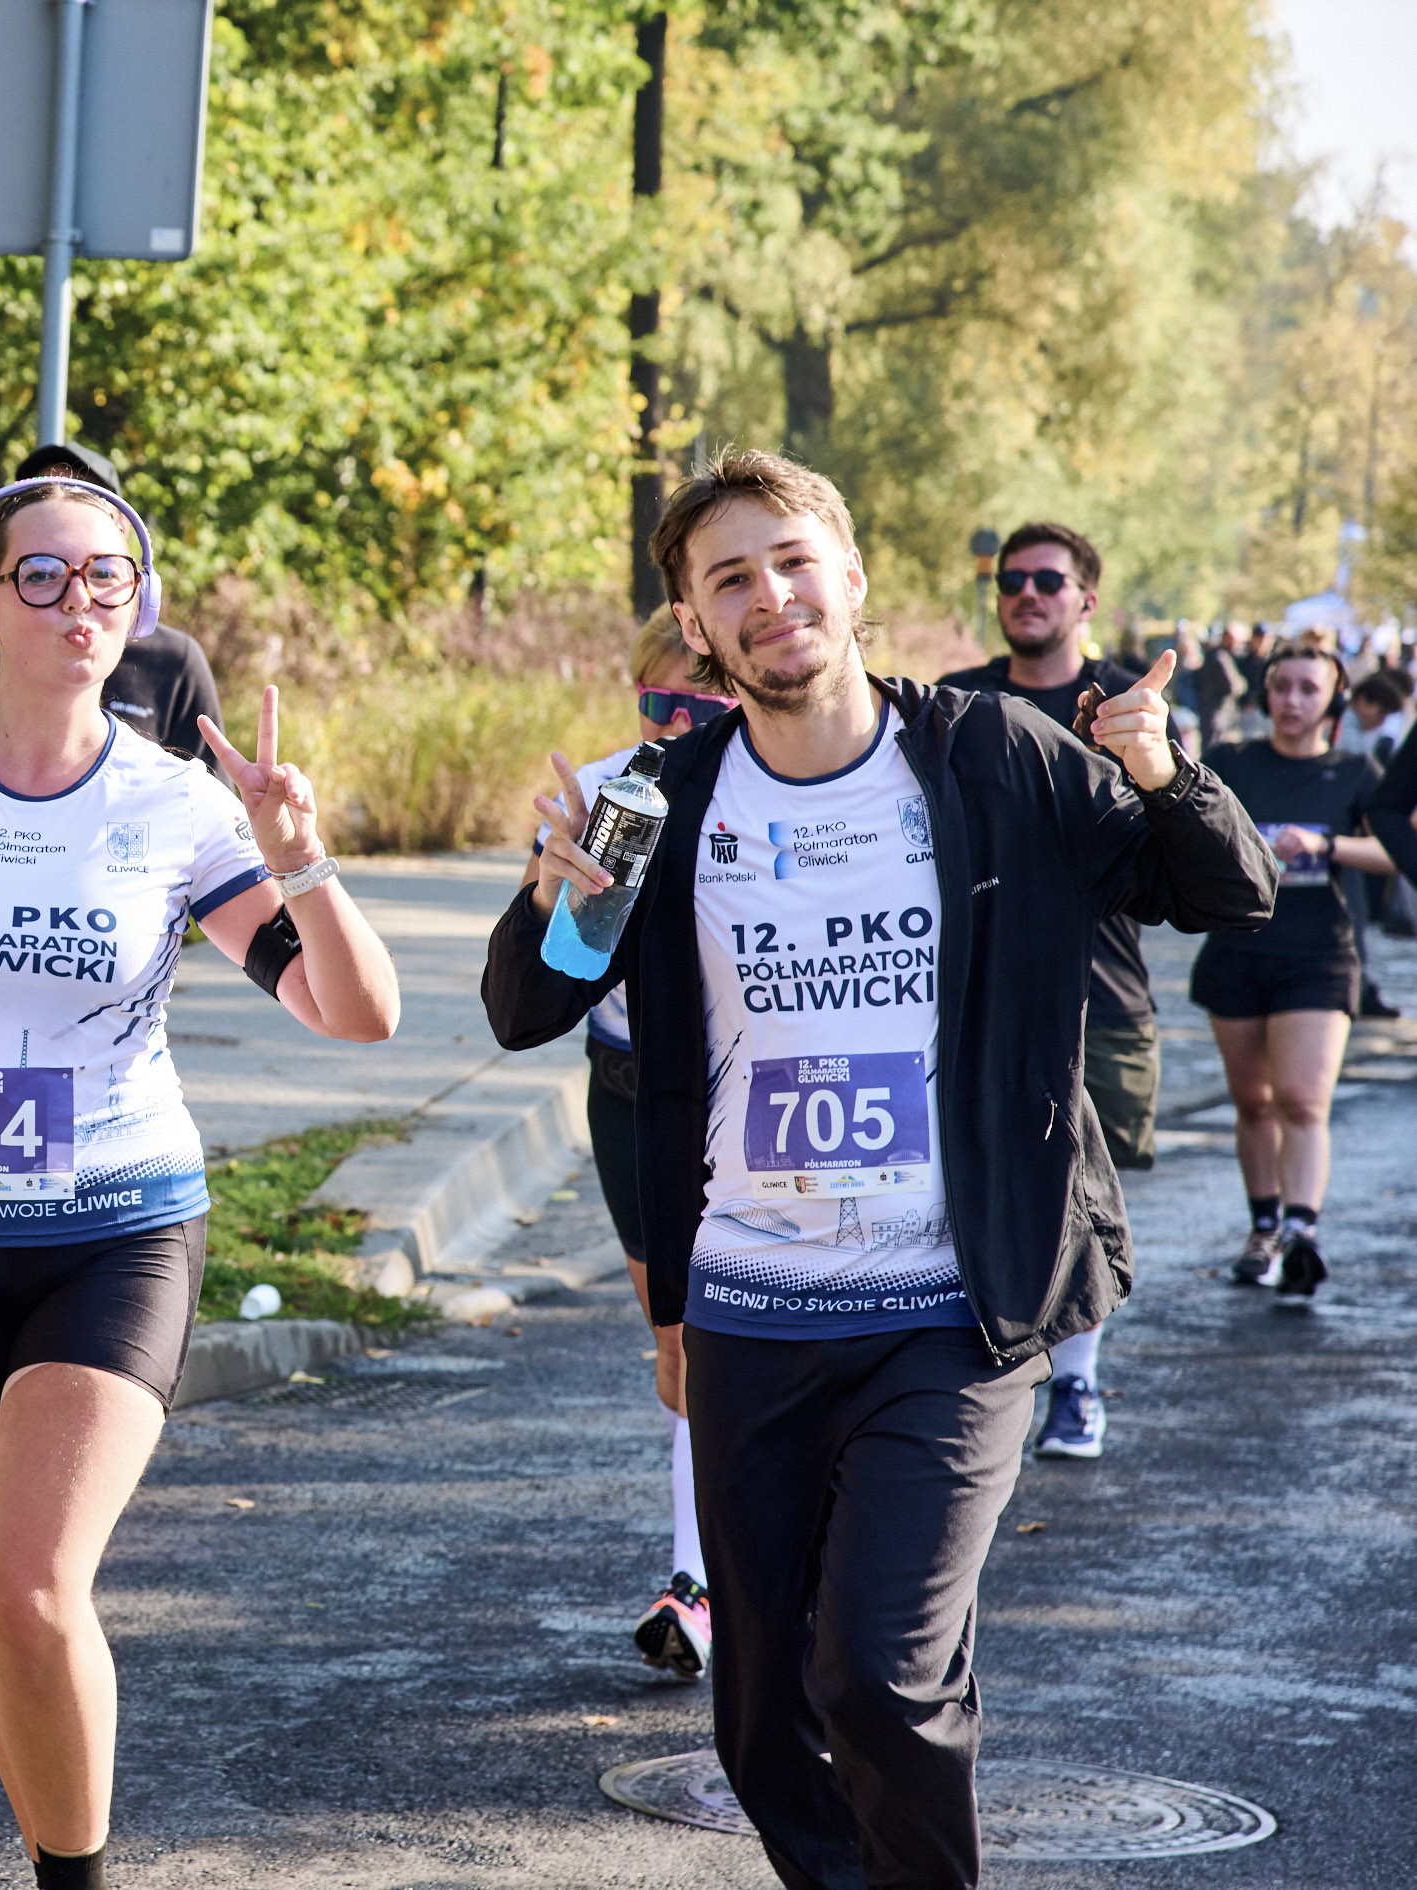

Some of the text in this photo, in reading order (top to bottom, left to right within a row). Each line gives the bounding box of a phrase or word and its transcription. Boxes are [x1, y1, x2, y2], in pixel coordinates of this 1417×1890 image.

[14, 831, 41, 841] PKO
[793, 821, 846, 839] 12. PKO
[793, 833, 878, 852] Półmaraton
[798, 851, 848, 868] Gliwicki
[906, 851, 935, 864] GLIW
[107, 865, 149, 873] GLIWICE
[698, 872, 756, 883] Bank Polski
[972, 877, 999, 894] IPRUN
[12, 906, 117, 933] PKO
[731, 906, 933, 954] 12. PKO
[736, 945, 935, 982] PÓŁMARATON
[744, 971, 935, 1013] GLIWICKI
[798, 1057, 849, 1069] 12. PKO
[797, 1072, 850, 1084] GLIWICKI
[769, 1087, 895, 1153] 705
[804, 1158, 862, 1169] PÓŁMARATON
[762, 1181, 788, 1190] GLIWICE
[62, 1189, 142, 1214] GLIWICE
[704, 1282, 769, 1310] BIEGNIJ
[773, 1297, 801, 1312] PO
[805, 1298, 876, 1312] SWOJE
